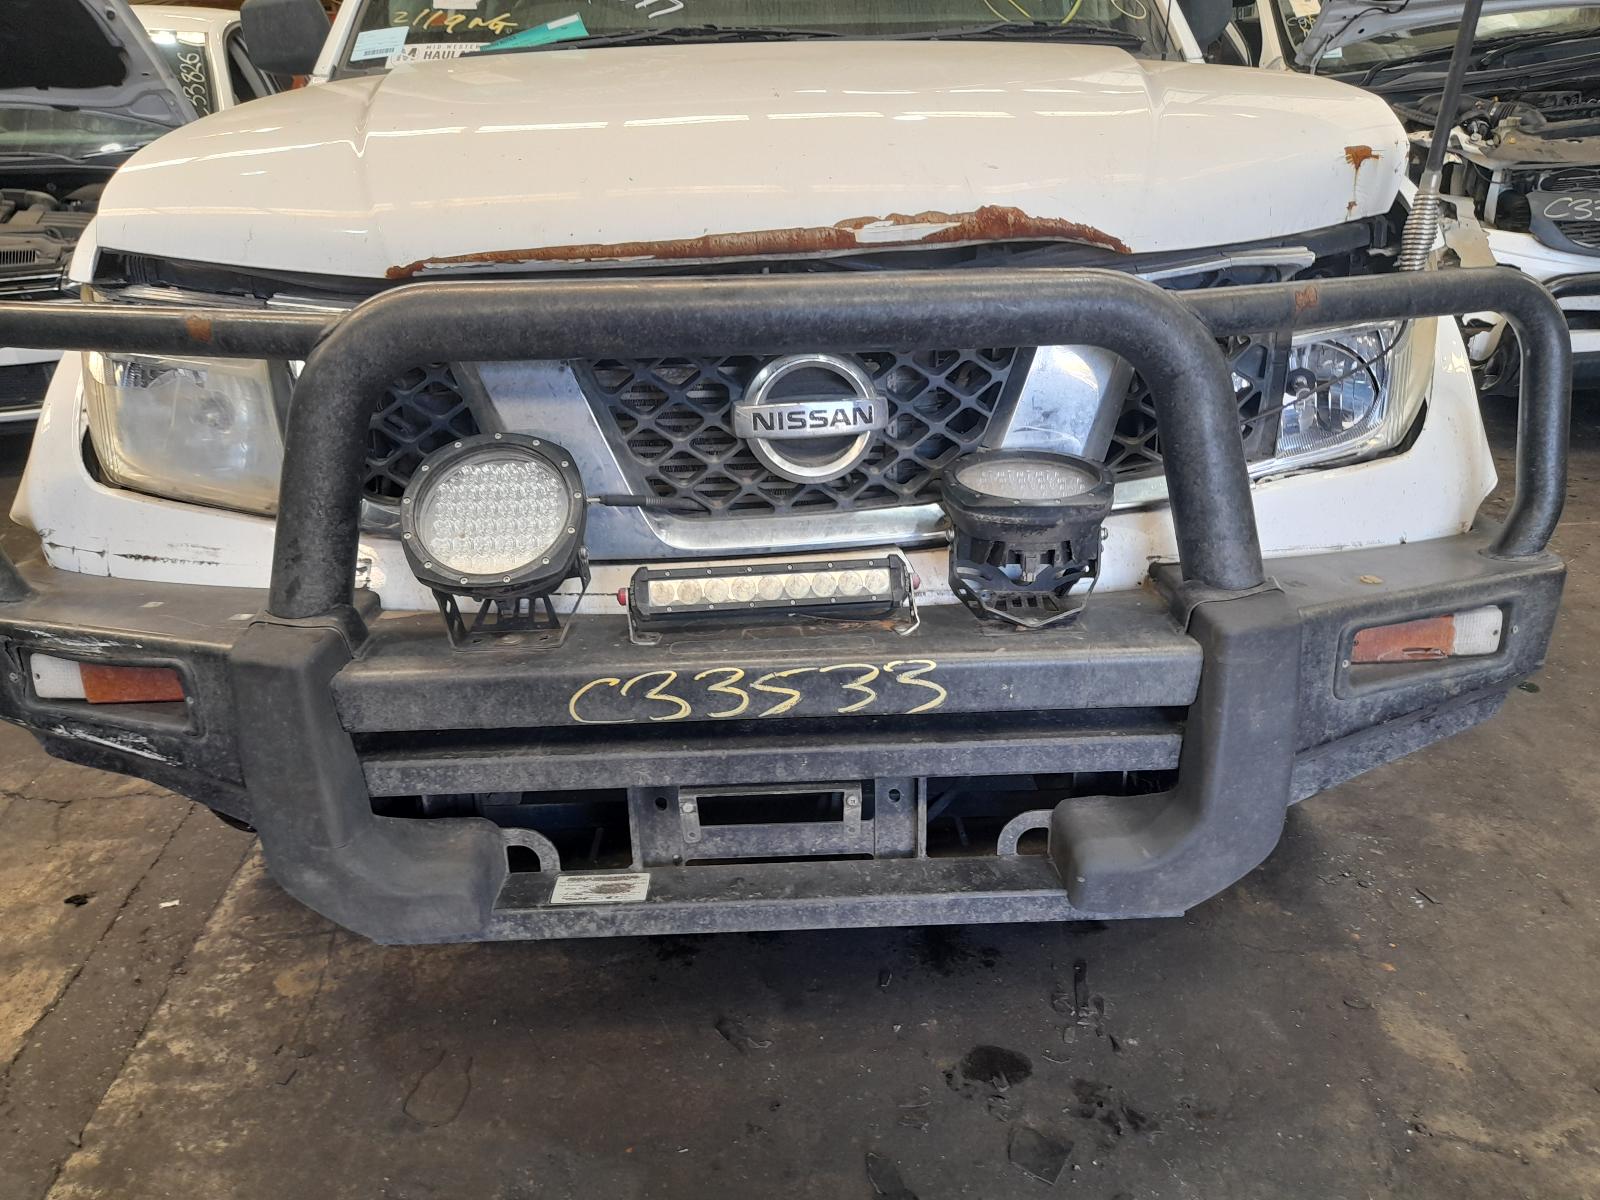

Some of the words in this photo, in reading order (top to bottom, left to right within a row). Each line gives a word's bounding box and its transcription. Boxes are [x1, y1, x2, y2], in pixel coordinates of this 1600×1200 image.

[177, 52, 210, 116] 33826
[1543, 197, 1600, 221] C3
[752, 405, 874, 431] NISSAN
